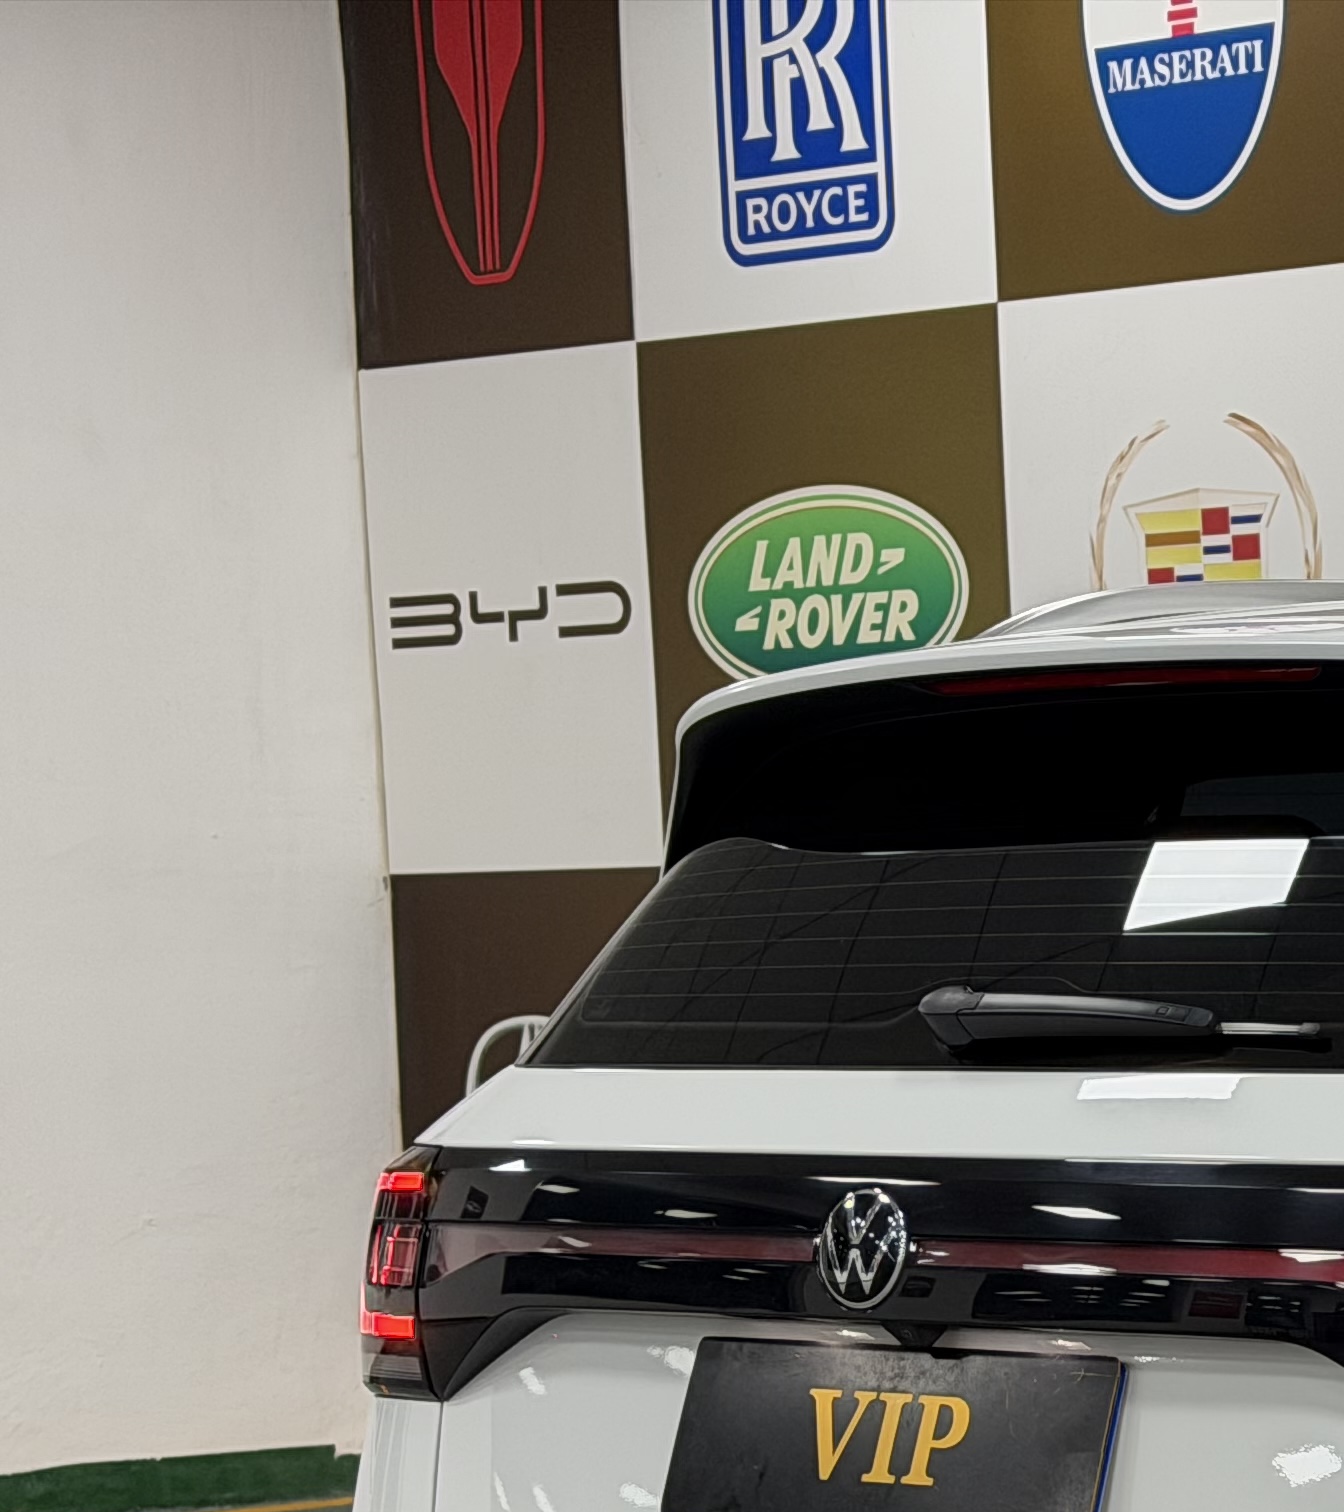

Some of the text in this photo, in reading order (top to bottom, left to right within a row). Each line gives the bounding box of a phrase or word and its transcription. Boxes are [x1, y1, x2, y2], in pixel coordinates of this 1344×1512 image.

[1106, 38, 1265, 95] MASERATI
[745, 183, 870, 237] ROYCE
[748, 532, 875, 593] LAND
[388, 580, 632, 650] BYD
[762, 590, 920, 651] ROVER
[808, 1387, 971, 1487] VIP
